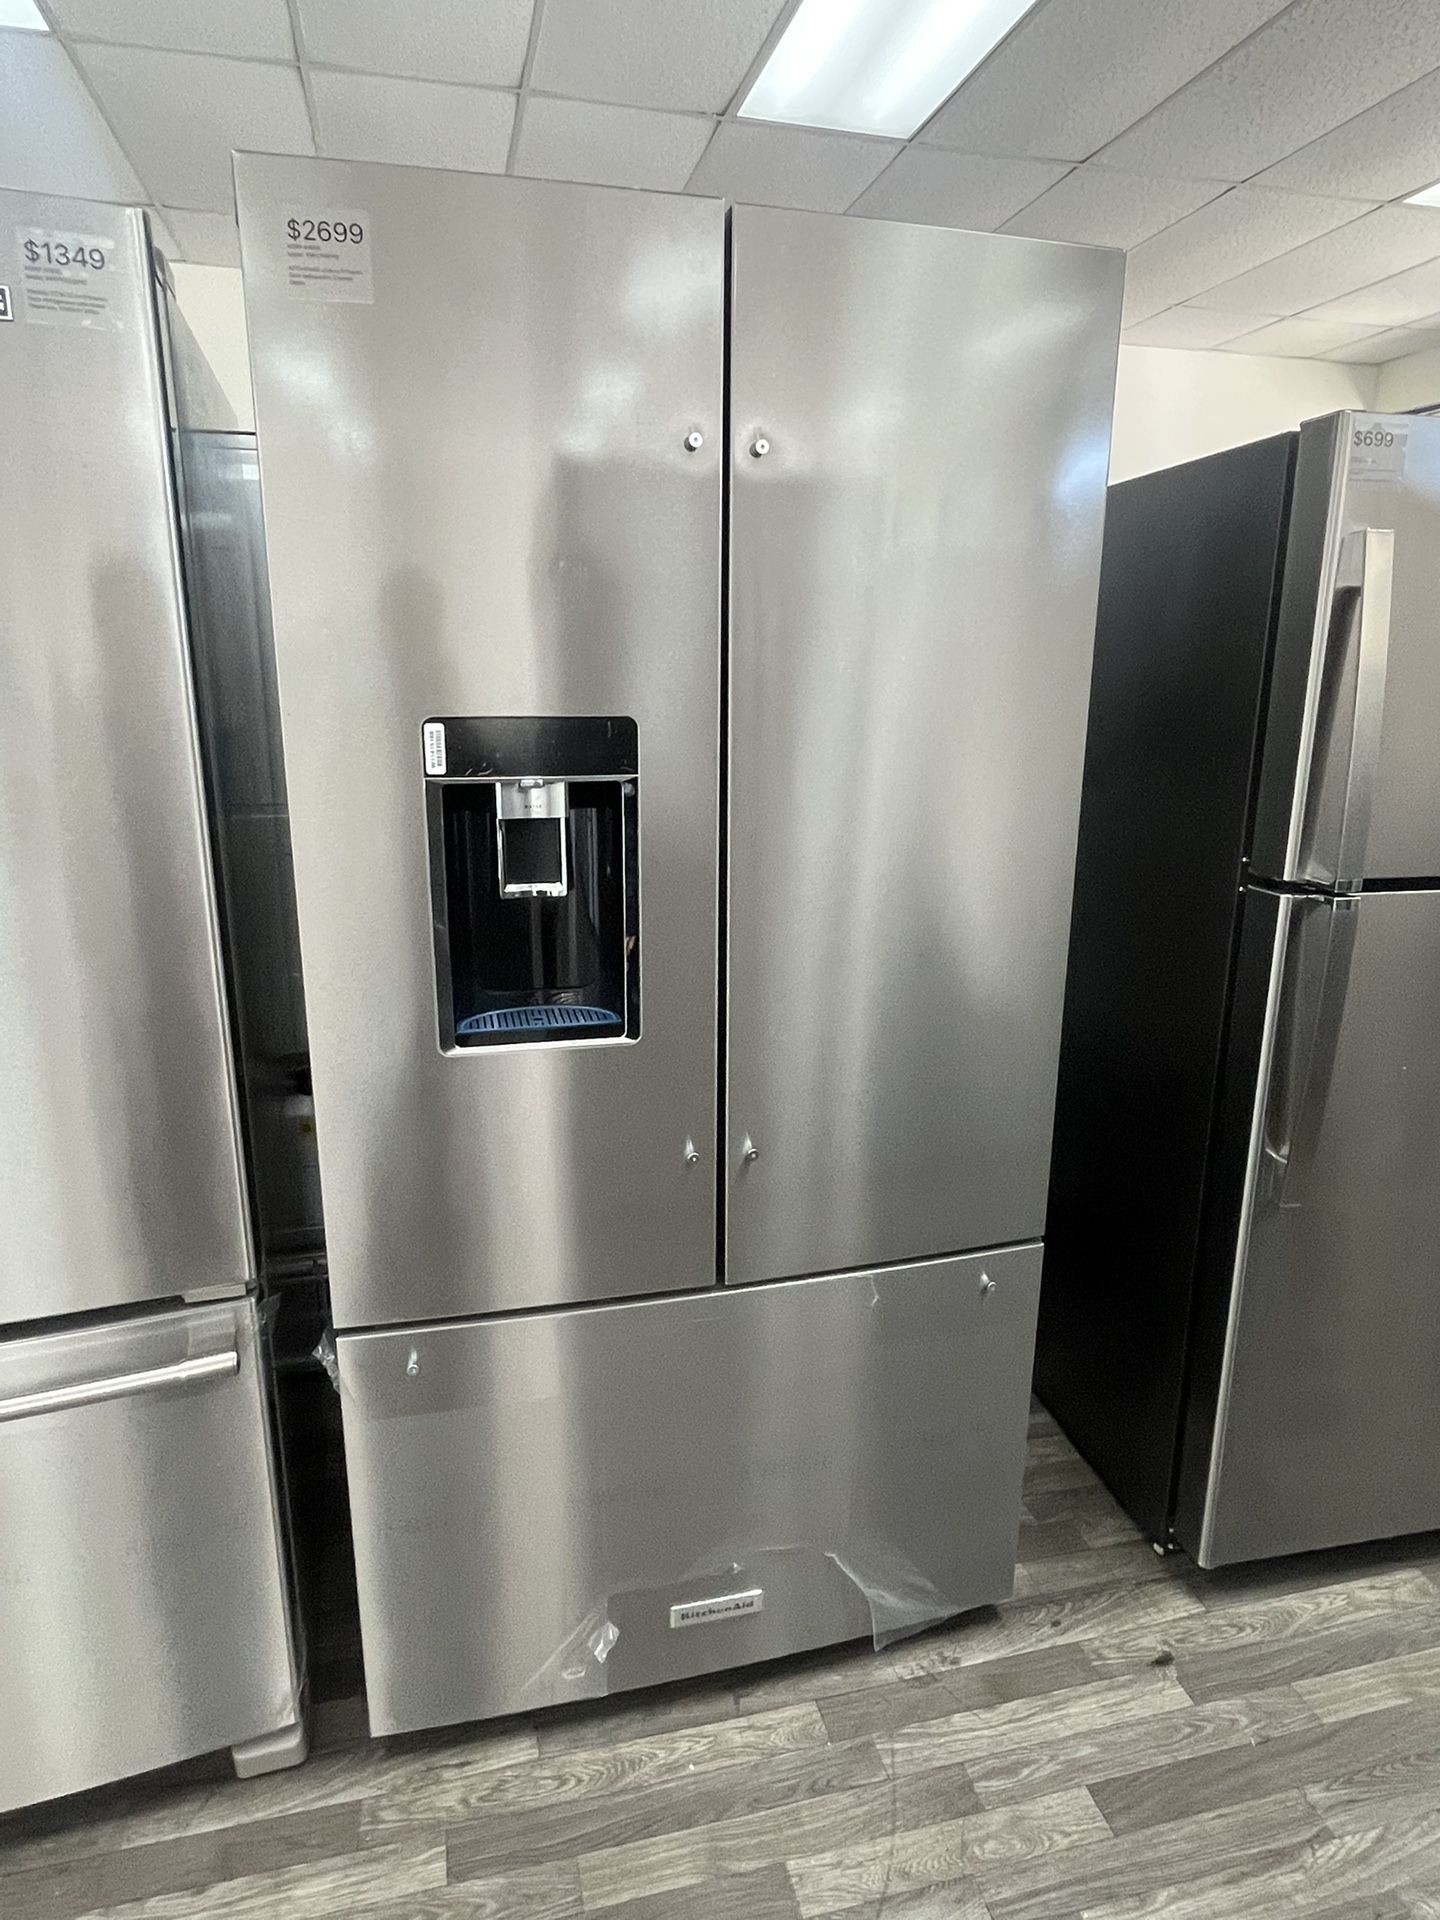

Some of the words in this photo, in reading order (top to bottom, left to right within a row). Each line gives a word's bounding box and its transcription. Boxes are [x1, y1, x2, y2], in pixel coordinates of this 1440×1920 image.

[287, 218, 363, 244] $2699
[24, 239, 105, 270] $1349
[1354, 431, 1394, 447] $699
